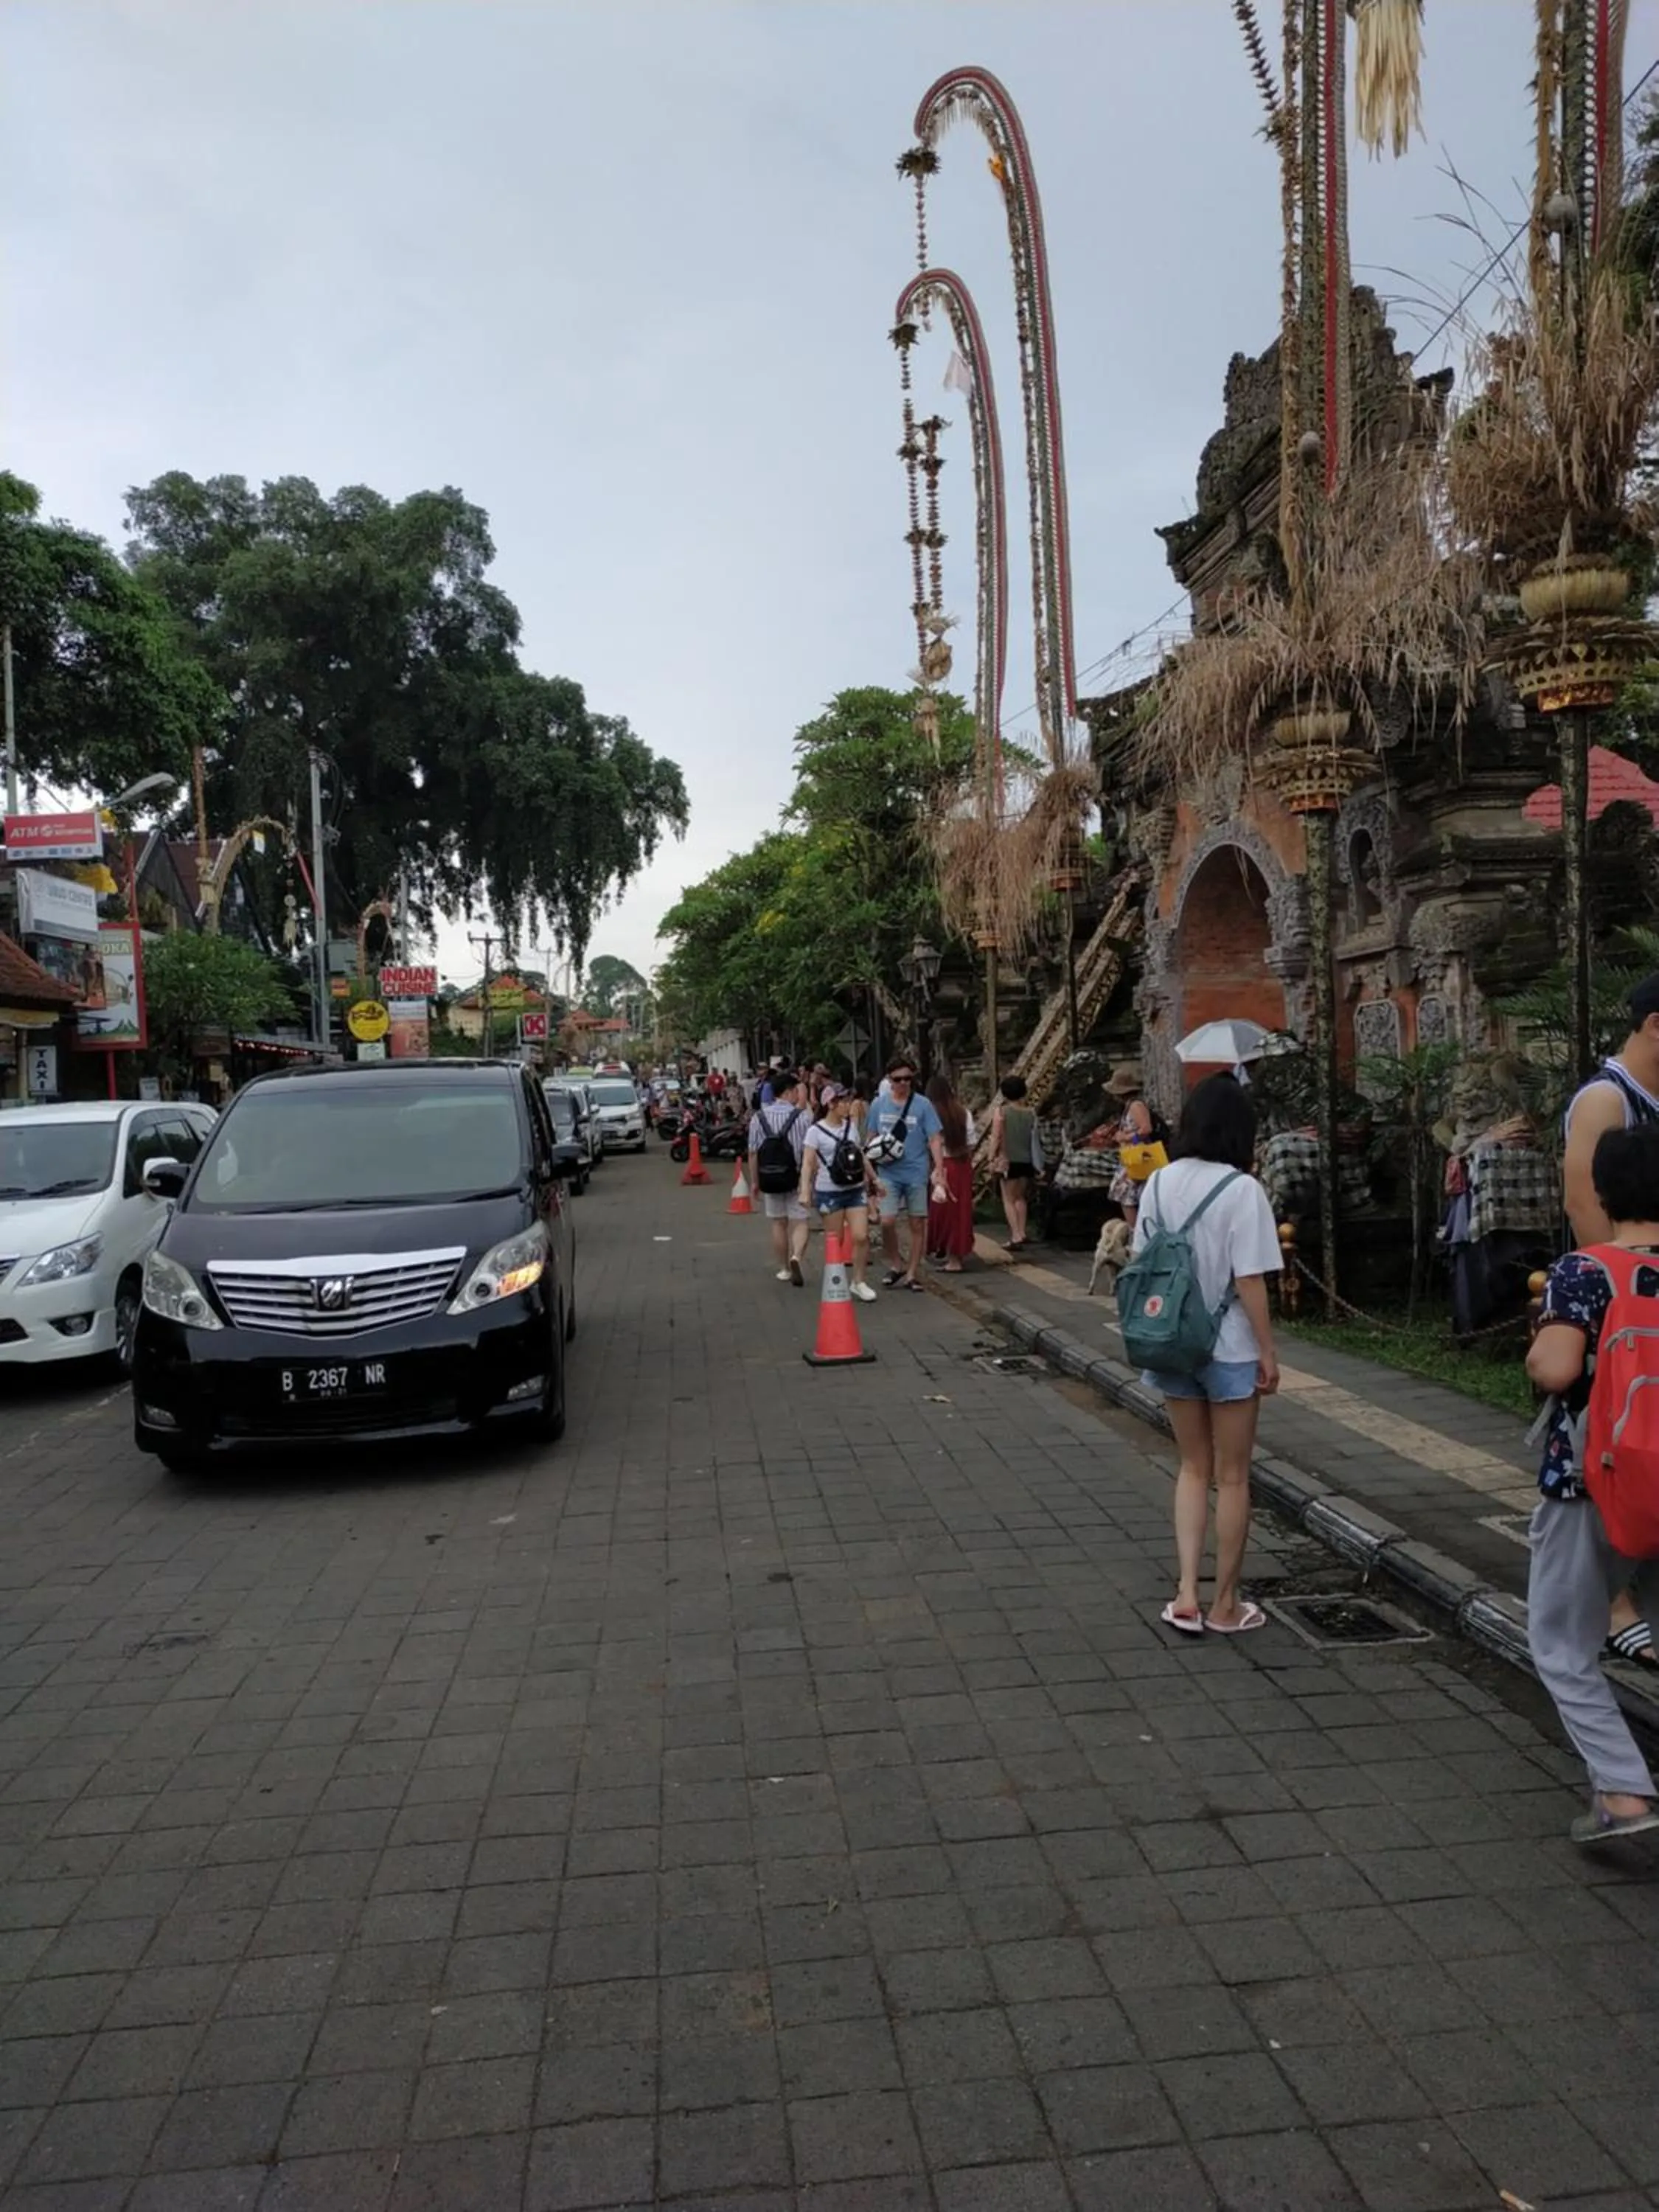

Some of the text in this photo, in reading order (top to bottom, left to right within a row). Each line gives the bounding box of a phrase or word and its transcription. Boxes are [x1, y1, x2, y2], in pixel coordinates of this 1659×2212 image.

[10, 827, 39, 838] ATM
[380, 967, 435, 981] INDIAN
[383, 982, 436, 995] CUISINE
[35, 1048, 48, 1089] TAXI
[282, 1363, 386, 1391] B 2367 NR
